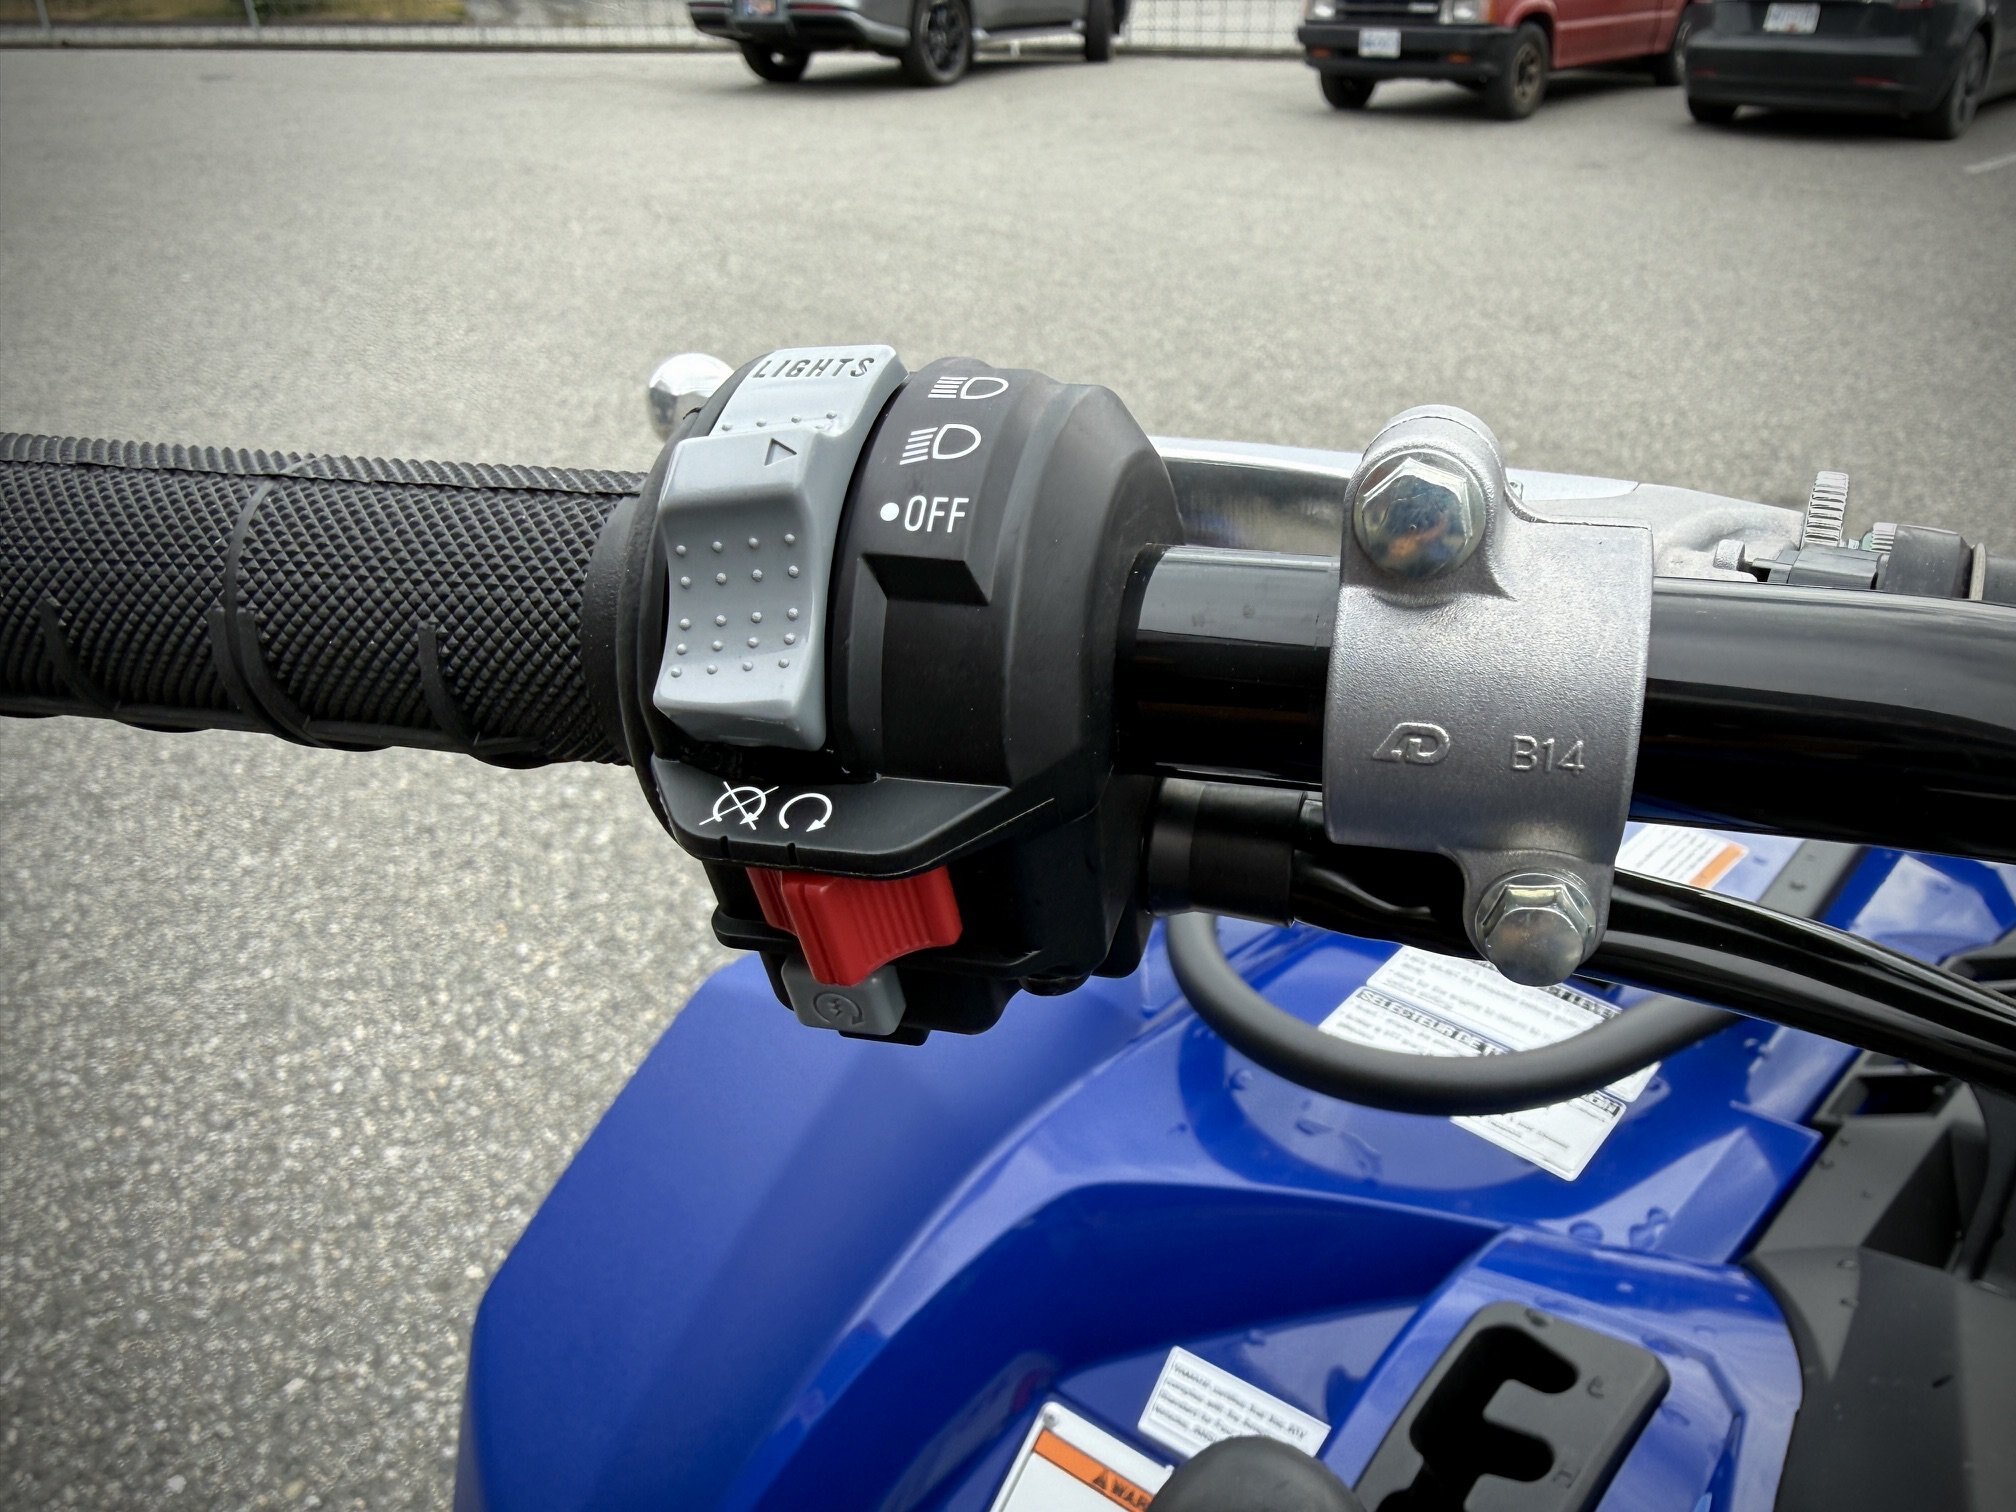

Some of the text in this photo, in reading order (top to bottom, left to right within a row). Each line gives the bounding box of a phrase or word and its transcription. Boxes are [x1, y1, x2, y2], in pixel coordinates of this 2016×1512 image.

[753, 356, 875, 379] LIGHTS
[904, 495, 970, 533] OFF
[1511, 734, 1585, 775] B14
